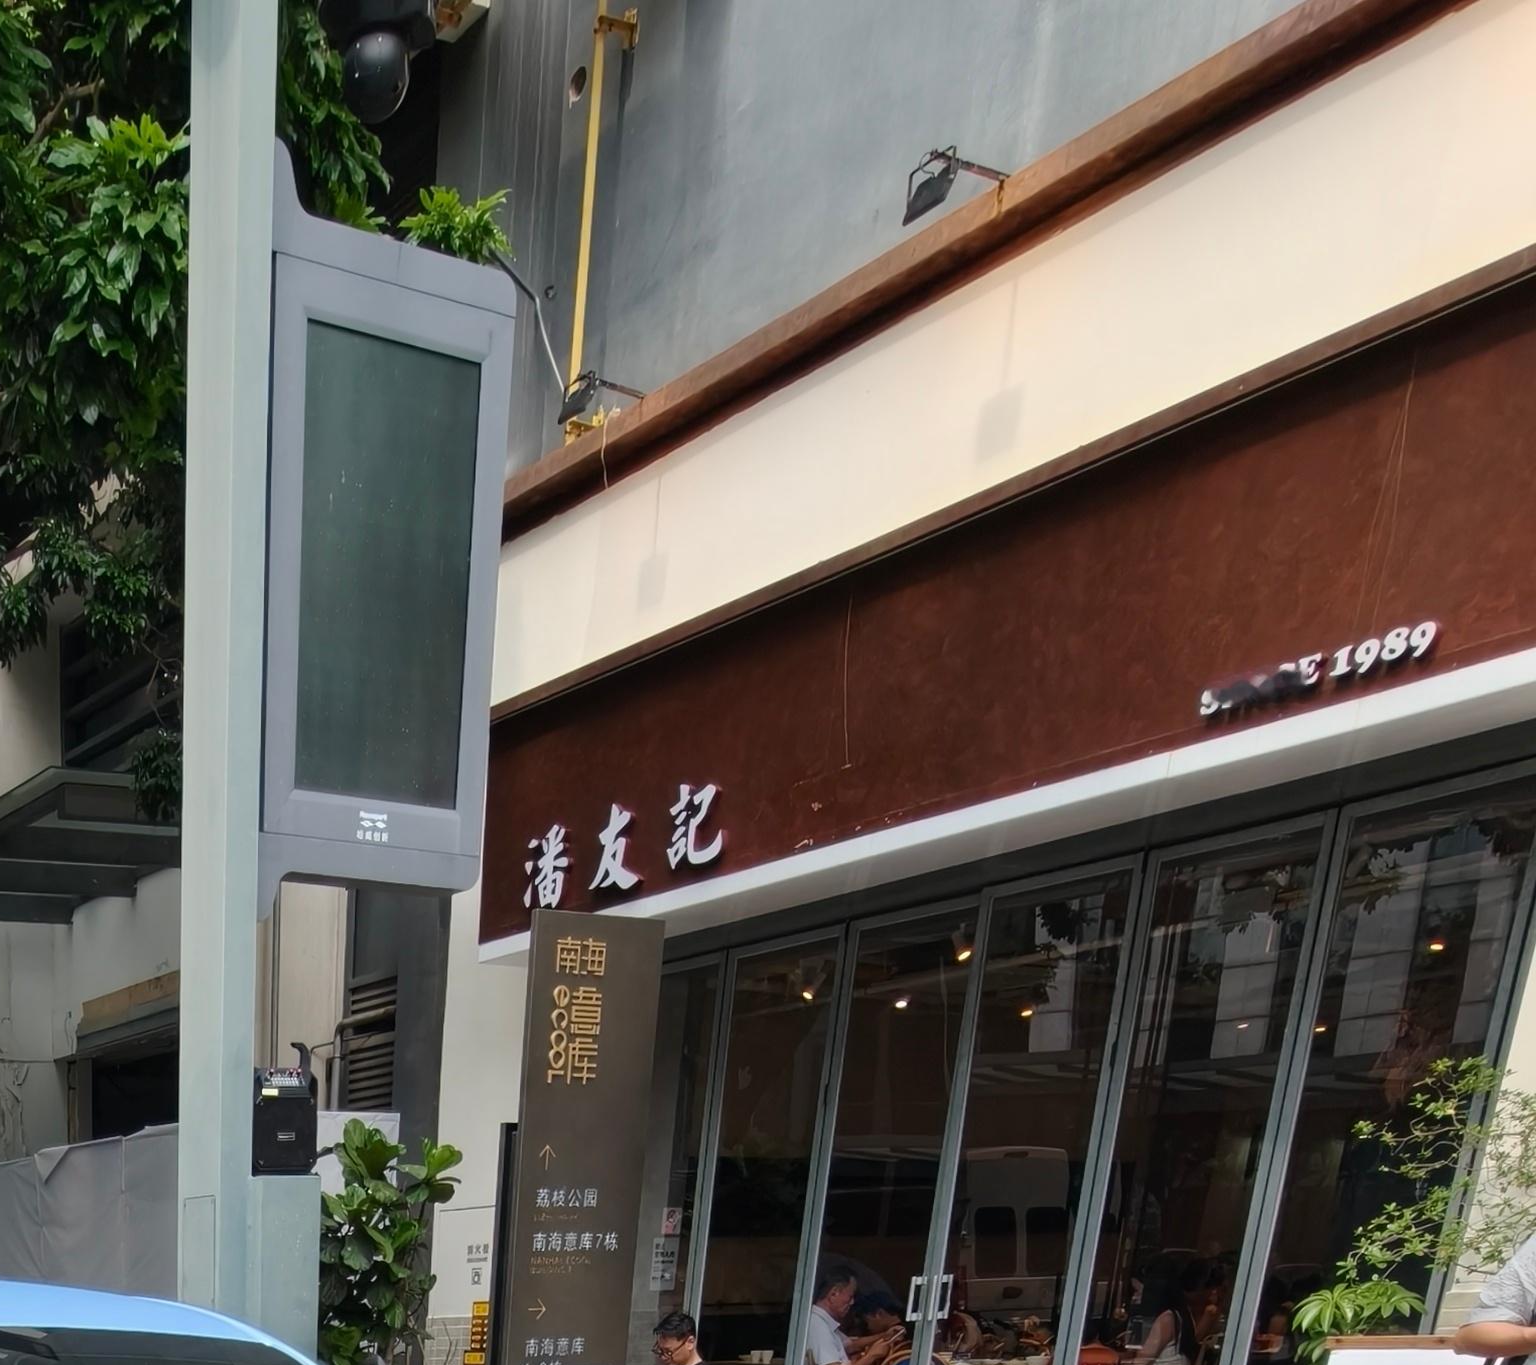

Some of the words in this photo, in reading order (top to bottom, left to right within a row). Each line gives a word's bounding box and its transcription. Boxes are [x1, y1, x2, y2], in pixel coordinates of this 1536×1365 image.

[1329, 621, 1438, 677] 1989
[523, 784, 724, 909] 潘友記
[535, 1187, 598, 1208] 荔枝公园
[532, 1231, 619, 1252] 南海意库7栋
[525, 1337, 585, 1357] 南海意库
